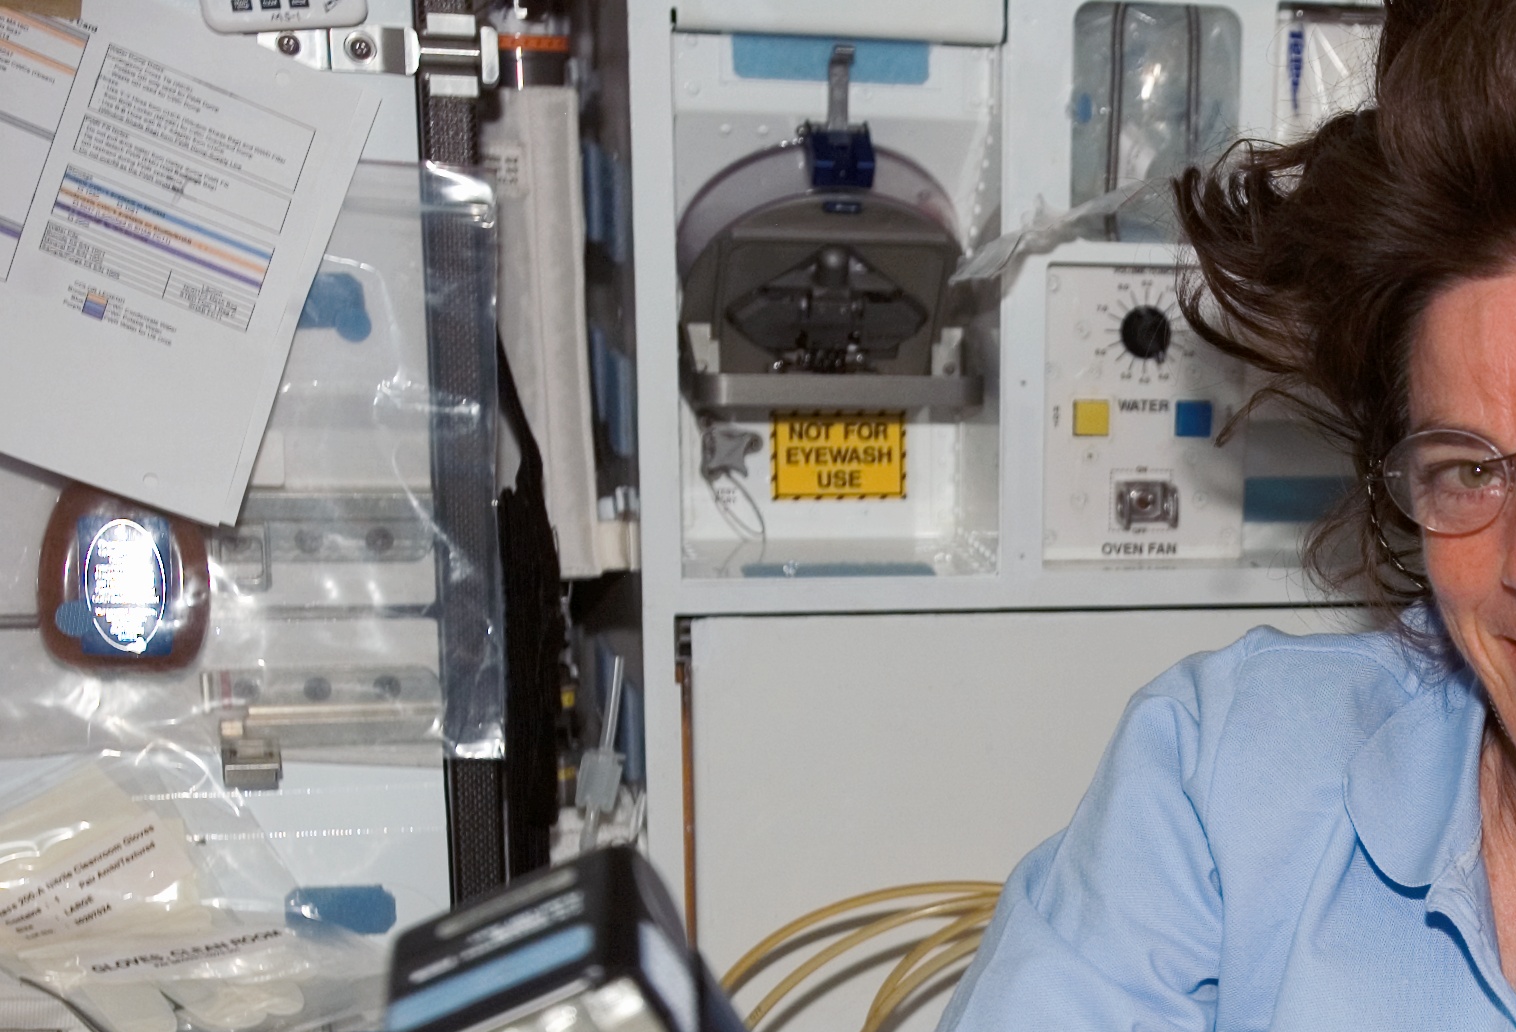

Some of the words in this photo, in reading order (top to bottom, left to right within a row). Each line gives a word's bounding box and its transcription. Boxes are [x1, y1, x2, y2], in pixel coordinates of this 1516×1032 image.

[1118, 400, 1169, 412] WATER
[788, 422, 832, 441] NOT
[844, 422, 888, 441] FOR
[786, 447, 891, 465] EYEWASH
[817, 469, 862, 488] USE
[1101, 542, 1143, 555] OVEN
[1147, 542, 1177, 555] FAN
[73, 843, 122, 874] Cleanroom
[122, 824, 155, 846] Gloves
[64, 893, 94, 916] LARGE
[230, 928, 282, 948] ROOM
